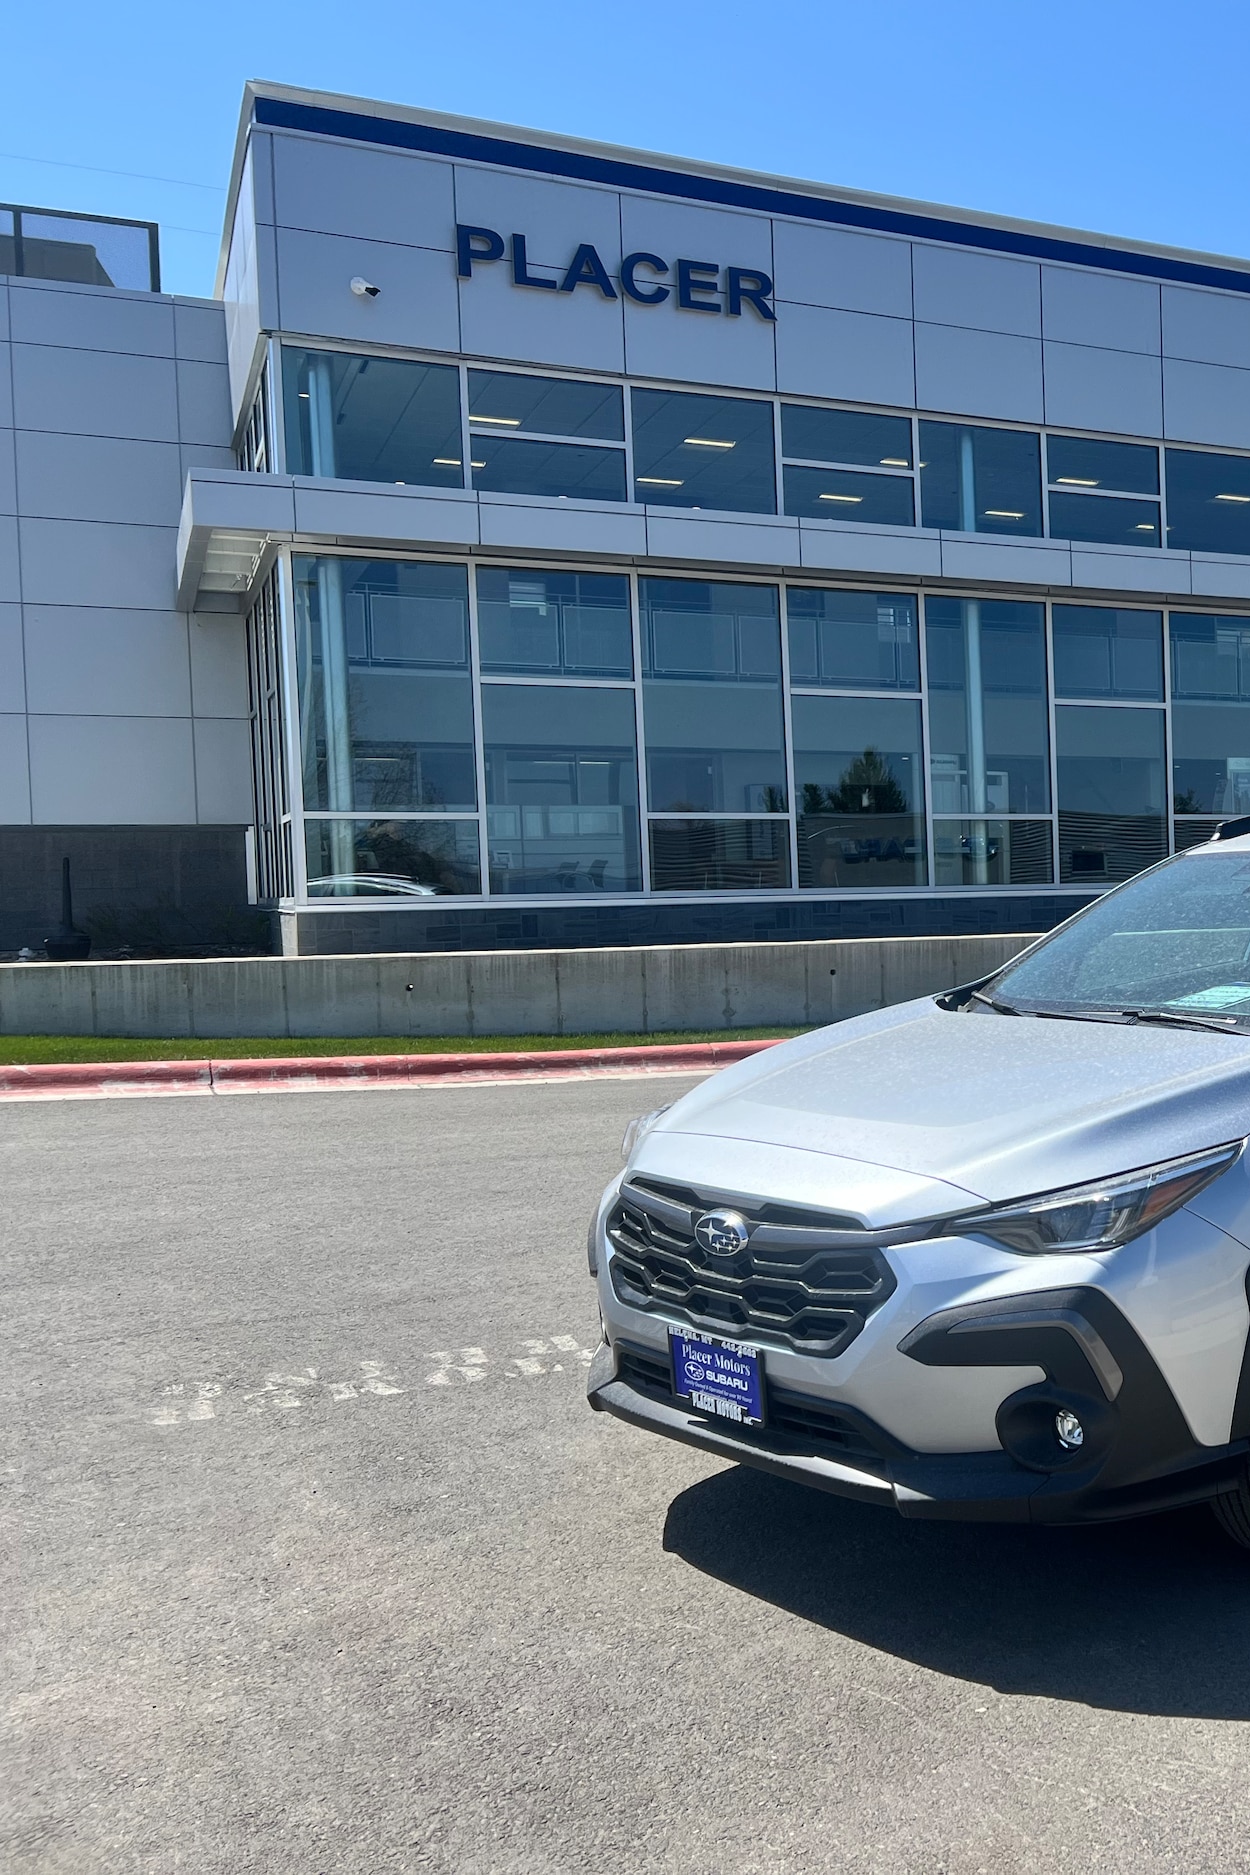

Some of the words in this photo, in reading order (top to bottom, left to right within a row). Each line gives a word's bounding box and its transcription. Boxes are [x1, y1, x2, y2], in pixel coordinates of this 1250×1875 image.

[456, 223, 777, 321] PLACER
[682, 1343, 713, 1366] Placer
[714, 1353, 751, 1377] Motors
[705, 1370, 748, 1391] SUBARU
[691, 1391, 716, 1414] PLACER
[715, 1399, 742, 1422] MOTORS
